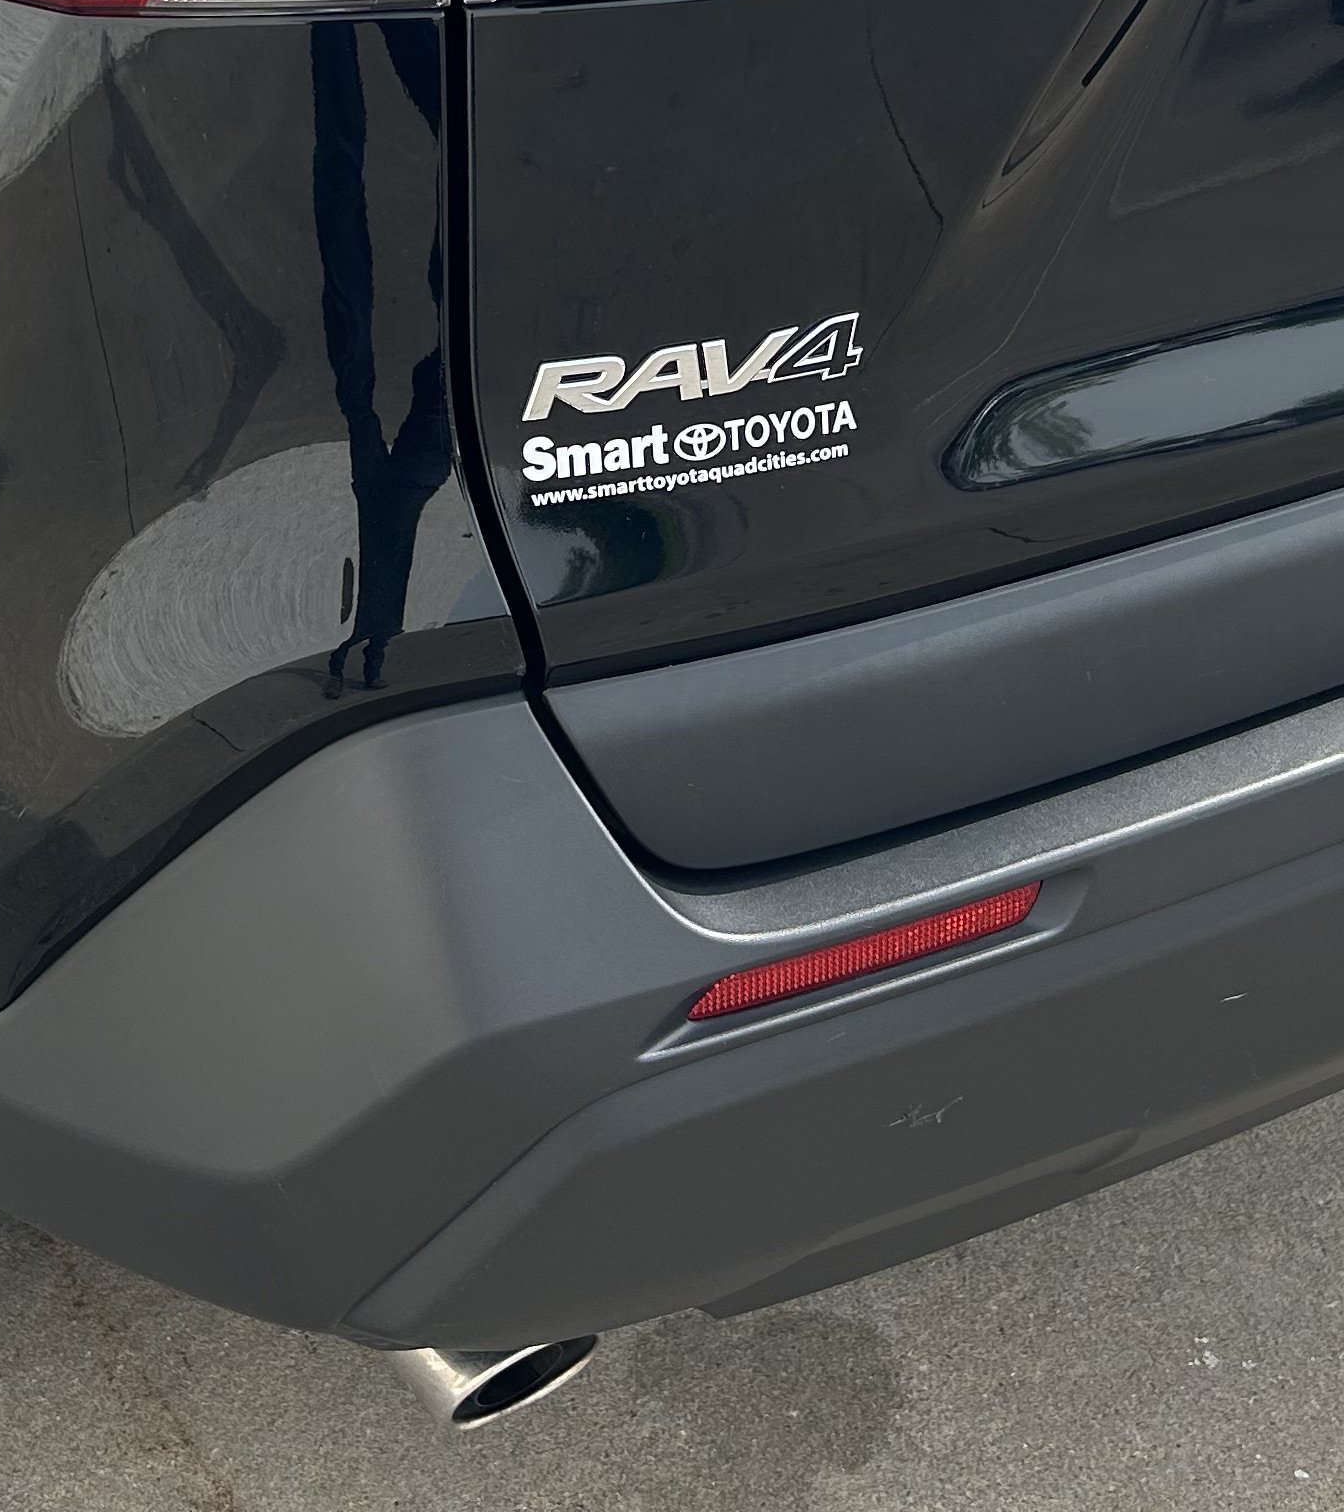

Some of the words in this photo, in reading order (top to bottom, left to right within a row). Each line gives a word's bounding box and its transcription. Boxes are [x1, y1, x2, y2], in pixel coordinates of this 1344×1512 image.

[521, 311, 864, 422] RAV4
[522, 424, 670, 483] Smart
[723, 400, 858, 451] TOYOTA
[531, 441, 850, 507] www.smarttoyotaquadcities.com
